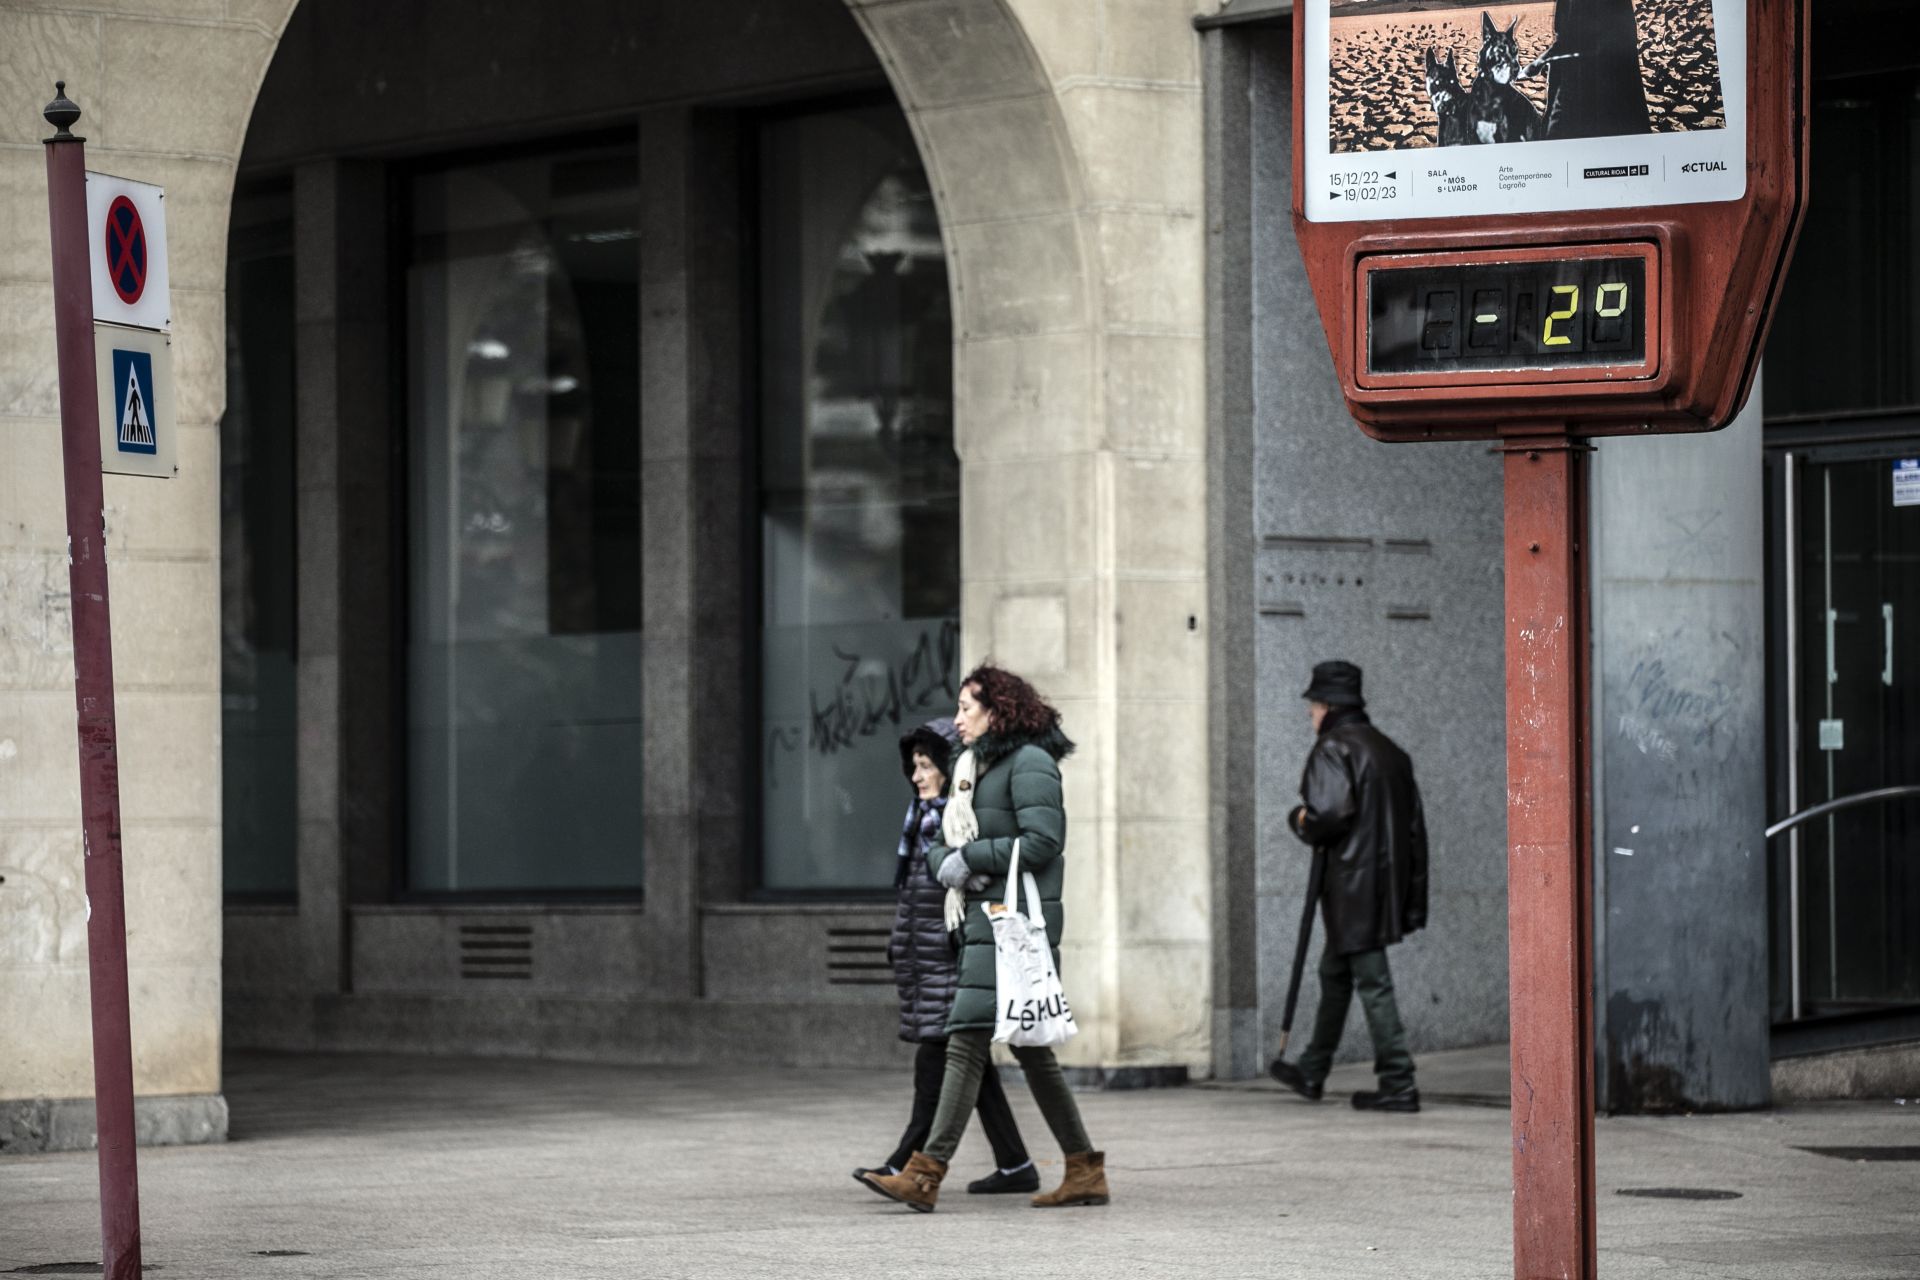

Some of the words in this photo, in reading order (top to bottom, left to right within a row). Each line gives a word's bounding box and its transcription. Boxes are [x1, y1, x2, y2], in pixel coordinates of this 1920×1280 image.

[1681, 161, 1728, 173] ACTUAL
[1329, 171, 1379, 187] 15/12/22
[1427, 169, 1448, 178] SALA
[1585, 170, 1611, 178] CULTURAL
[1611, 169, 1627, 177] RIOJA
[1344, 186, 1397, 203] 19/02/23
